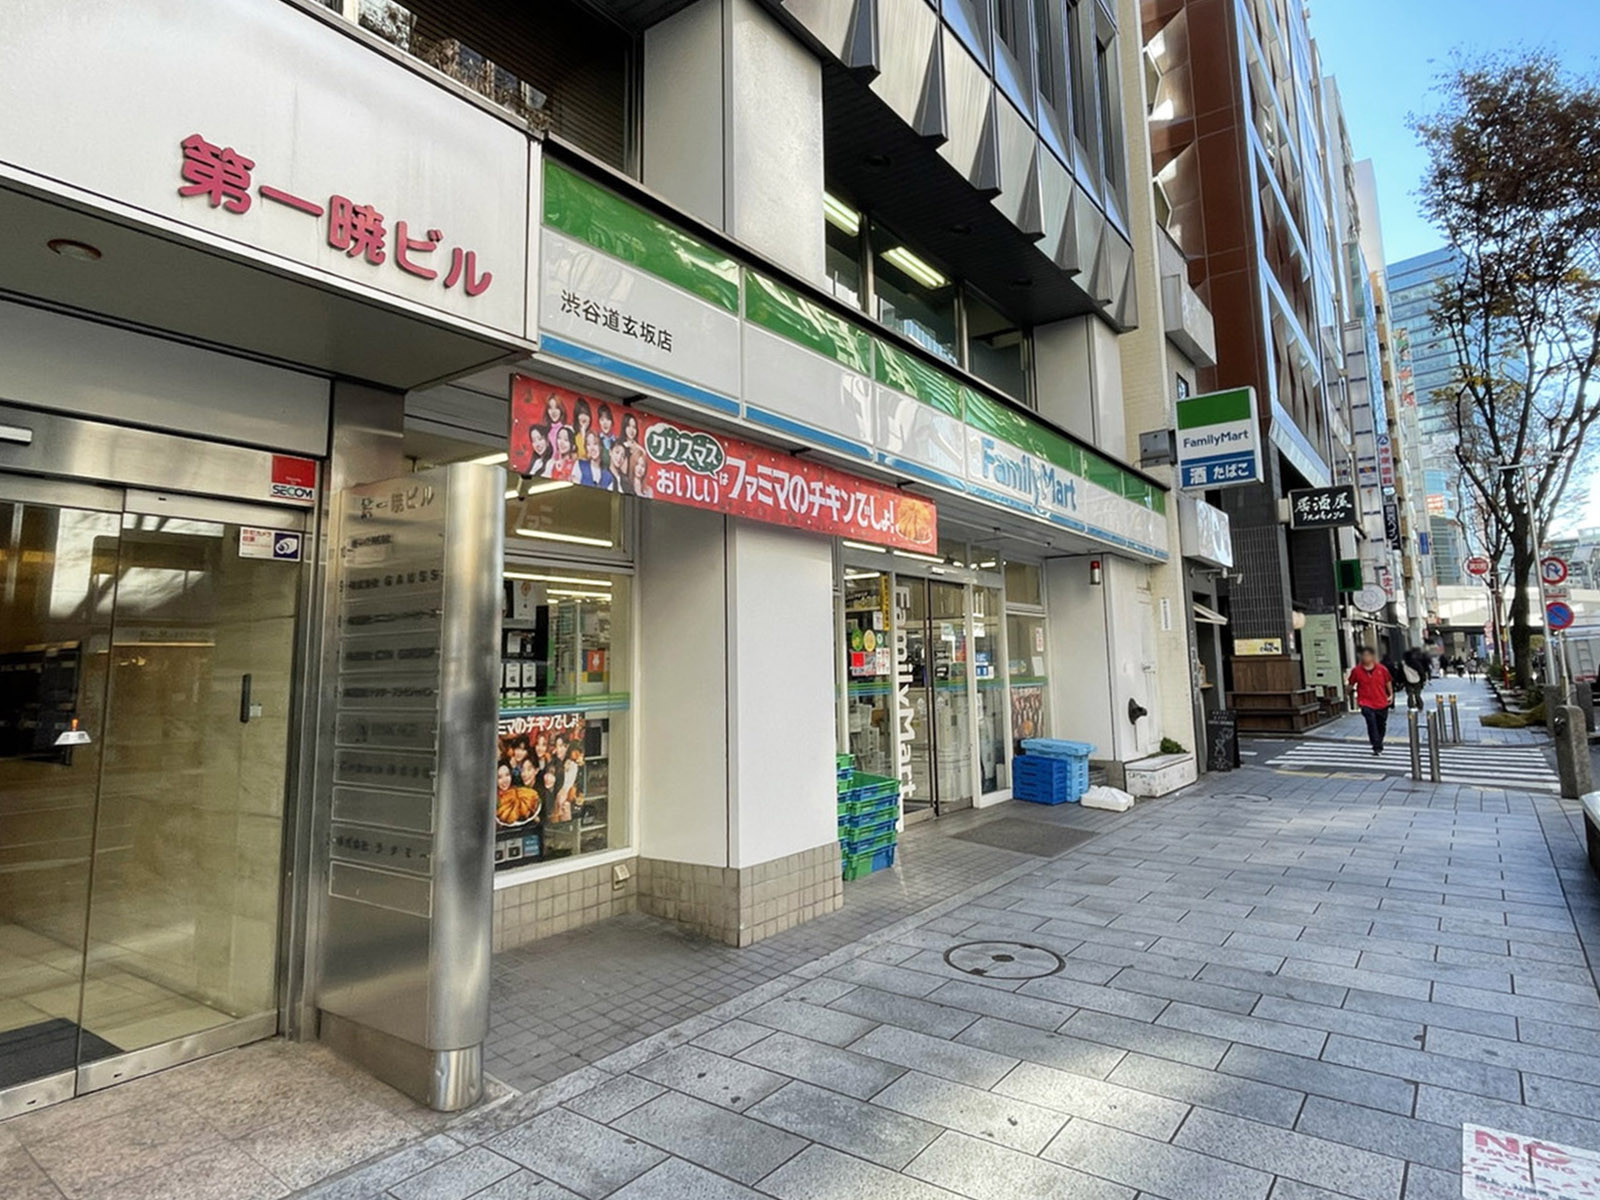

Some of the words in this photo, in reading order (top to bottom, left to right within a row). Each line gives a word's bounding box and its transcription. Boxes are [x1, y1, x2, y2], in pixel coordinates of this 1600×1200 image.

[178, 134, 493, 296] 第一暁ビル
[560, 289, 673, 353] 渋谷道玄坂店
[650, 431, 720, 471] クリスマス
[1183, 430, 1249, 448] FamilyMart
[272, 484, 313, 498] SECOM
[980, 437, 1077, 511] FamilyMart
[1190, 466, 1207, 484] 酒
[1213, 462, 1249, 480] たばこ
[896, 586, 917, 797] FamilyMart
